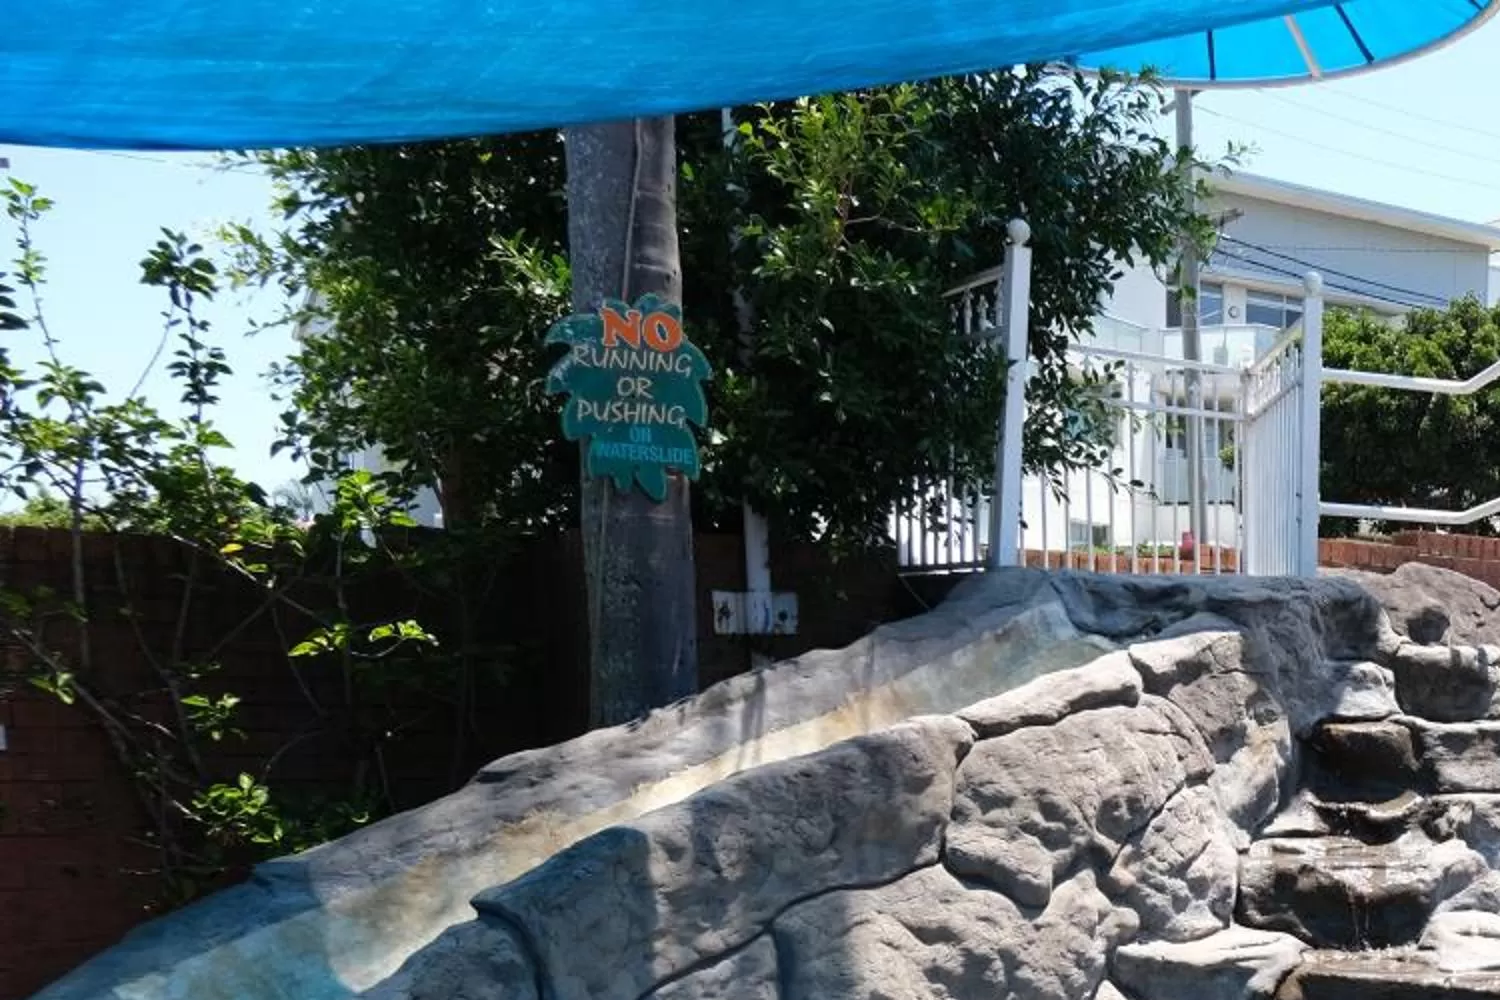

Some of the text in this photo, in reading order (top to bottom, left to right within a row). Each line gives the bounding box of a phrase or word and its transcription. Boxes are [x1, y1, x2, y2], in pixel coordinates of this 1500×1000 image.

[601, 307, 682, 351] NO
[573, 343, 692, 377] RUNNING
[617, 376, 653, 400] OR
[576, 399, 686, 429] PUSHING
[598, 442, 693, 465] WATERSLIDE
